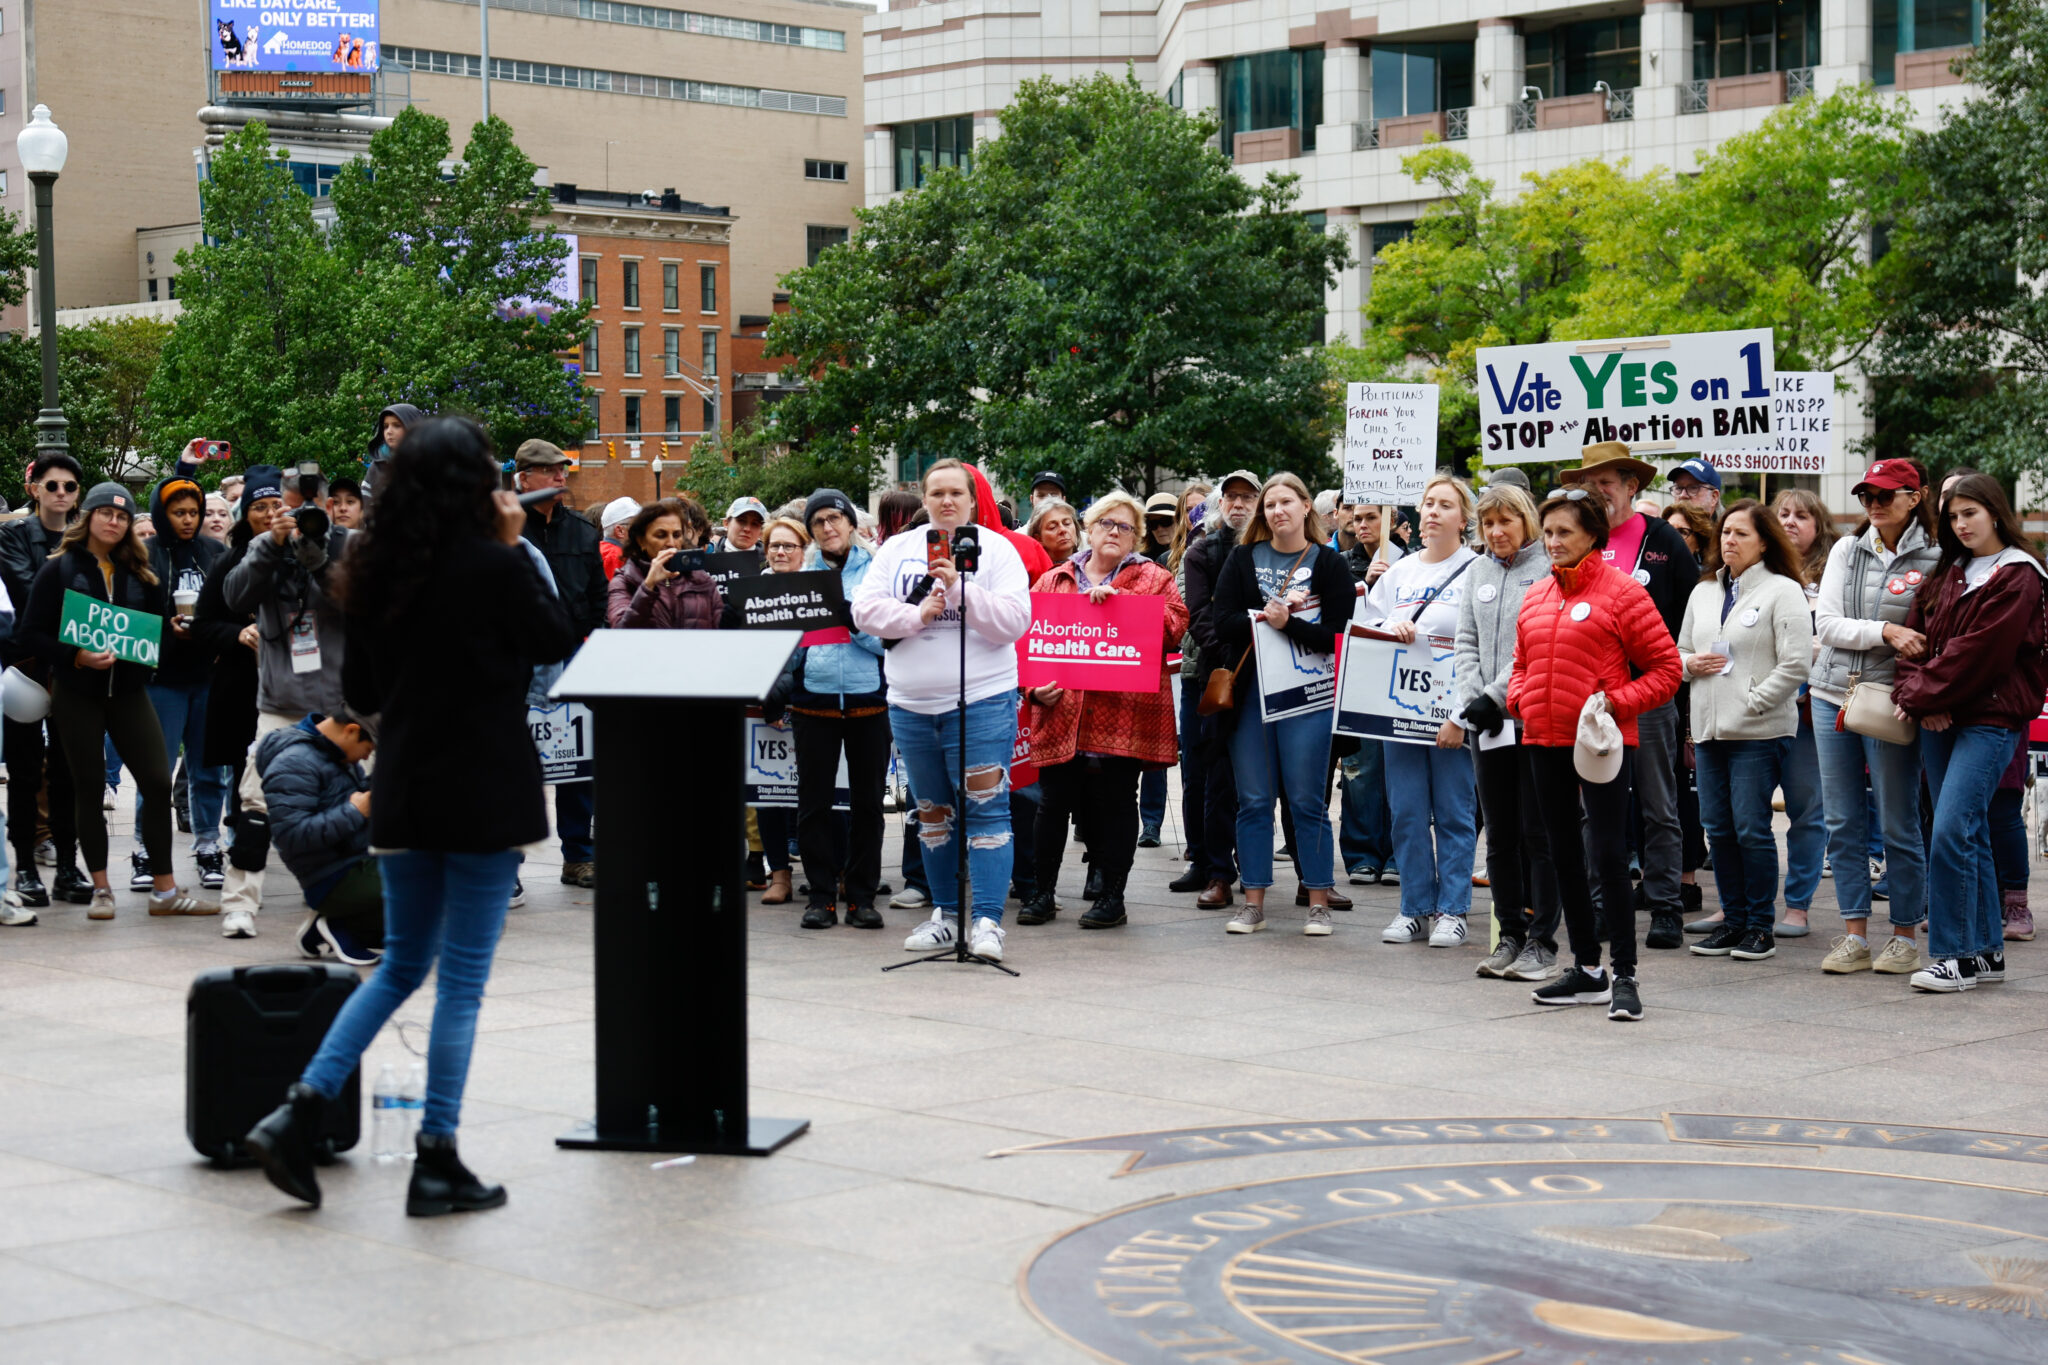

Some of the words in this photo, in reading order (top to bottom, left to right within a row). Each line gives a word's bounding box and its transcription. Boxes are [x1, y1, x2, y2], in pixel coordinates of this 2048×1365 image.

[220, 0, 257, 8] LIKE
[260, 0, 340, 12] DAYCARE,
[260, 12, 302, 26] ONLY
[307, 13, 375, 27] BETTER!
[283, 41, 332, 50] HOMEDOG
[1485, 361, 1562, 414] Vote
[1569, 353, 1679, 409] YES
[1691, 377, 1729, 401] on
[1740, 342, 1770, 398] 1
[1775, 378, 1804, 392] IKE
[1361, 385, 1424, 401] POLITICIANS
[1349, 406, 1388, 419] FORCING
[1394, 406, 1416, 419] YOUR
[1487, 421, 1554, 450] STOP
[1560, 420, 1579, 434] the
[1583, 414, 1703, 446] Abortion
[1713, 405, 1769, 436] BAN
[1790, 417, 1830, 432] LIKE
[1379, 437, 1385, 446] A
[1372, 449, 1403, 460] DOES
[1703, 453, 1742, 469] MASS
[1745, 454, 1825, 472] SHOOTINGS!
[1397, 475, 1425, 490] RIGHTS
[1358, 495, 1370, 503] YES
[745, 593, 808, 610] Abortion
[810, 591, 823, 603] is
[88, 603, 130, 632] PRO
[746, 609, 793, 624] Health
[796, 607, 833, 618] Care.
[1029, 620, 1101, 637] Abortion
[1107, 623, 1118, 637] is
[64, 619, 159, 663] ABORTION
[1028, 639, 1090, 656] Health
[1095, 642, 1141, 658] Care.
[1304, 685, 1316, 695] Stop
[1316, 680, 1335, 691] Abortio
[1399, 668, 1432, 693] YES
[1431, 707, 1452, 719] ISSU
[1393, 719, 1409, 730] Stop
[1409, 721, 1440, 732] Abortion
[555, 749, 576, 759] ISSUE
[570, 716, 584, 756] 1
[758, 740, 787, 760] YES
[758, 786, 772, 795] Stop
[1094, 1229, 1220, 1318] STATE
[1192, 1200, 1308, 1231] OF
[1327, 1174, 1603, 1208] OHIO
